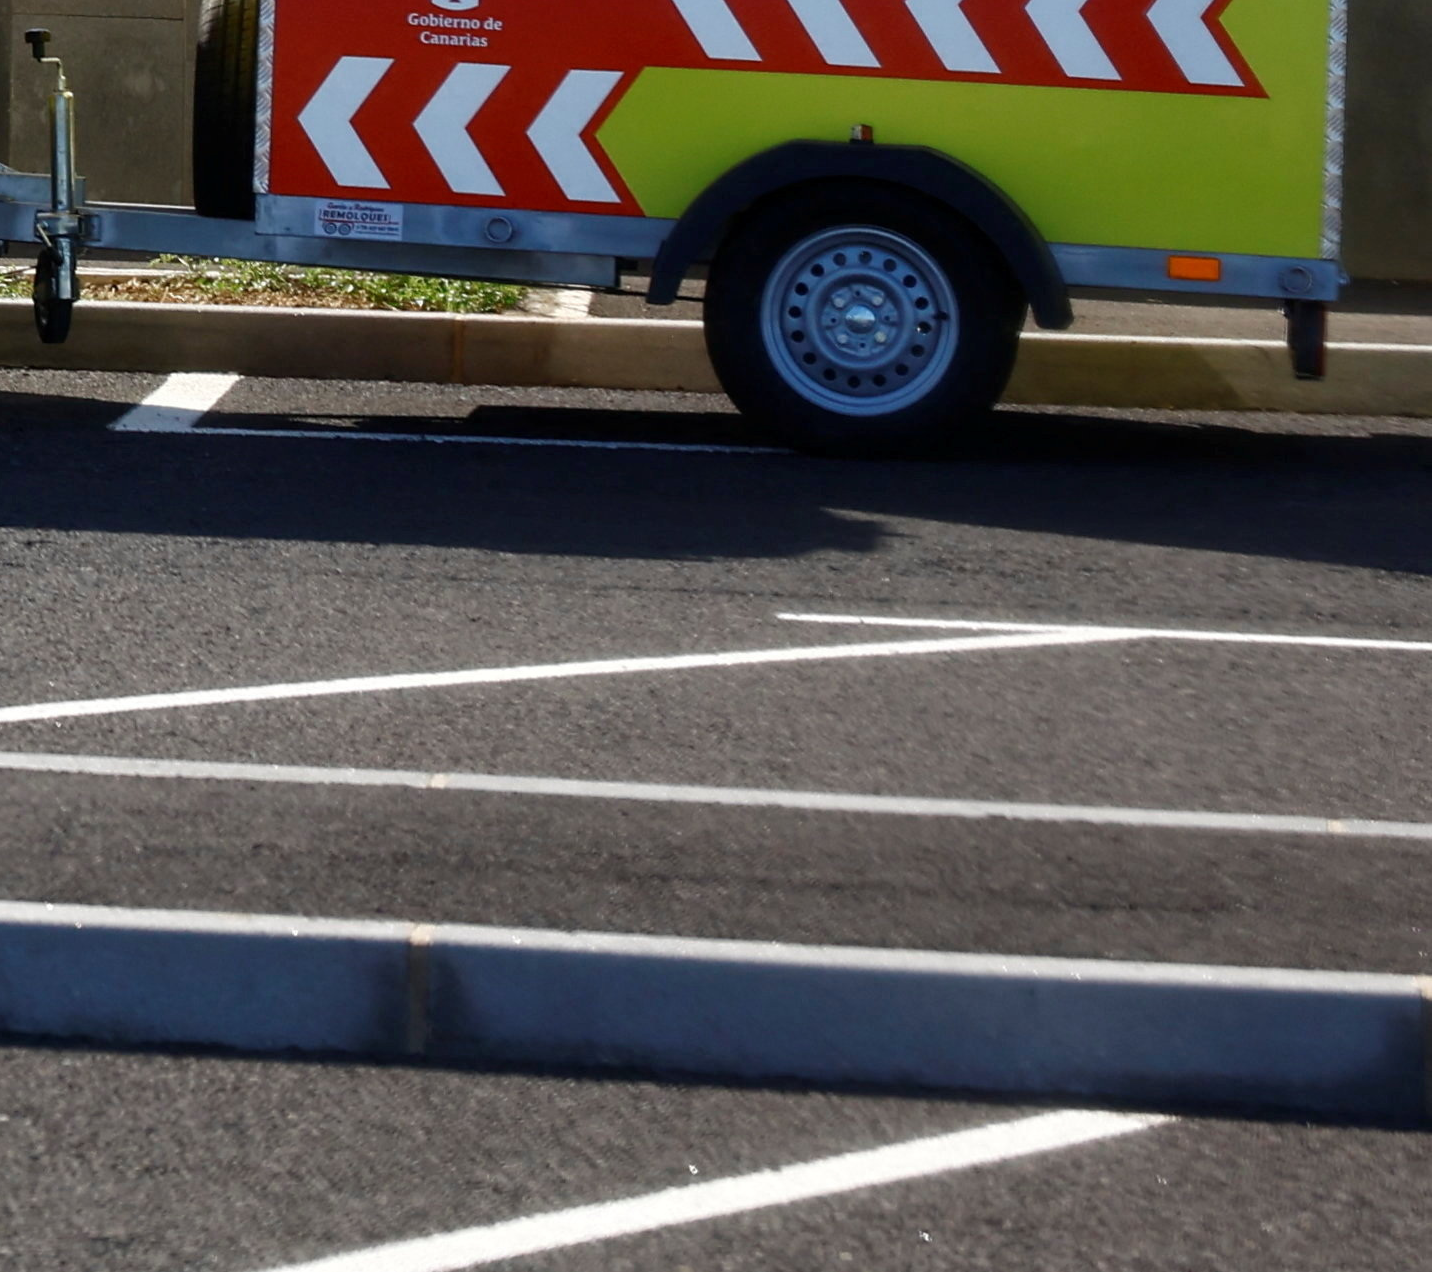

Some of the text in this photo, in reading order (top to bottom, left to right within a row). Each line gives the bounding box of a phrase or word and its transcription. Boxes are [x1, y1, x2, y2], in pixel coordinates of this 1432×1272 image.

[408, 13, 503, 30] Gobierno de
[420, 31, 488, 47] Canarias
